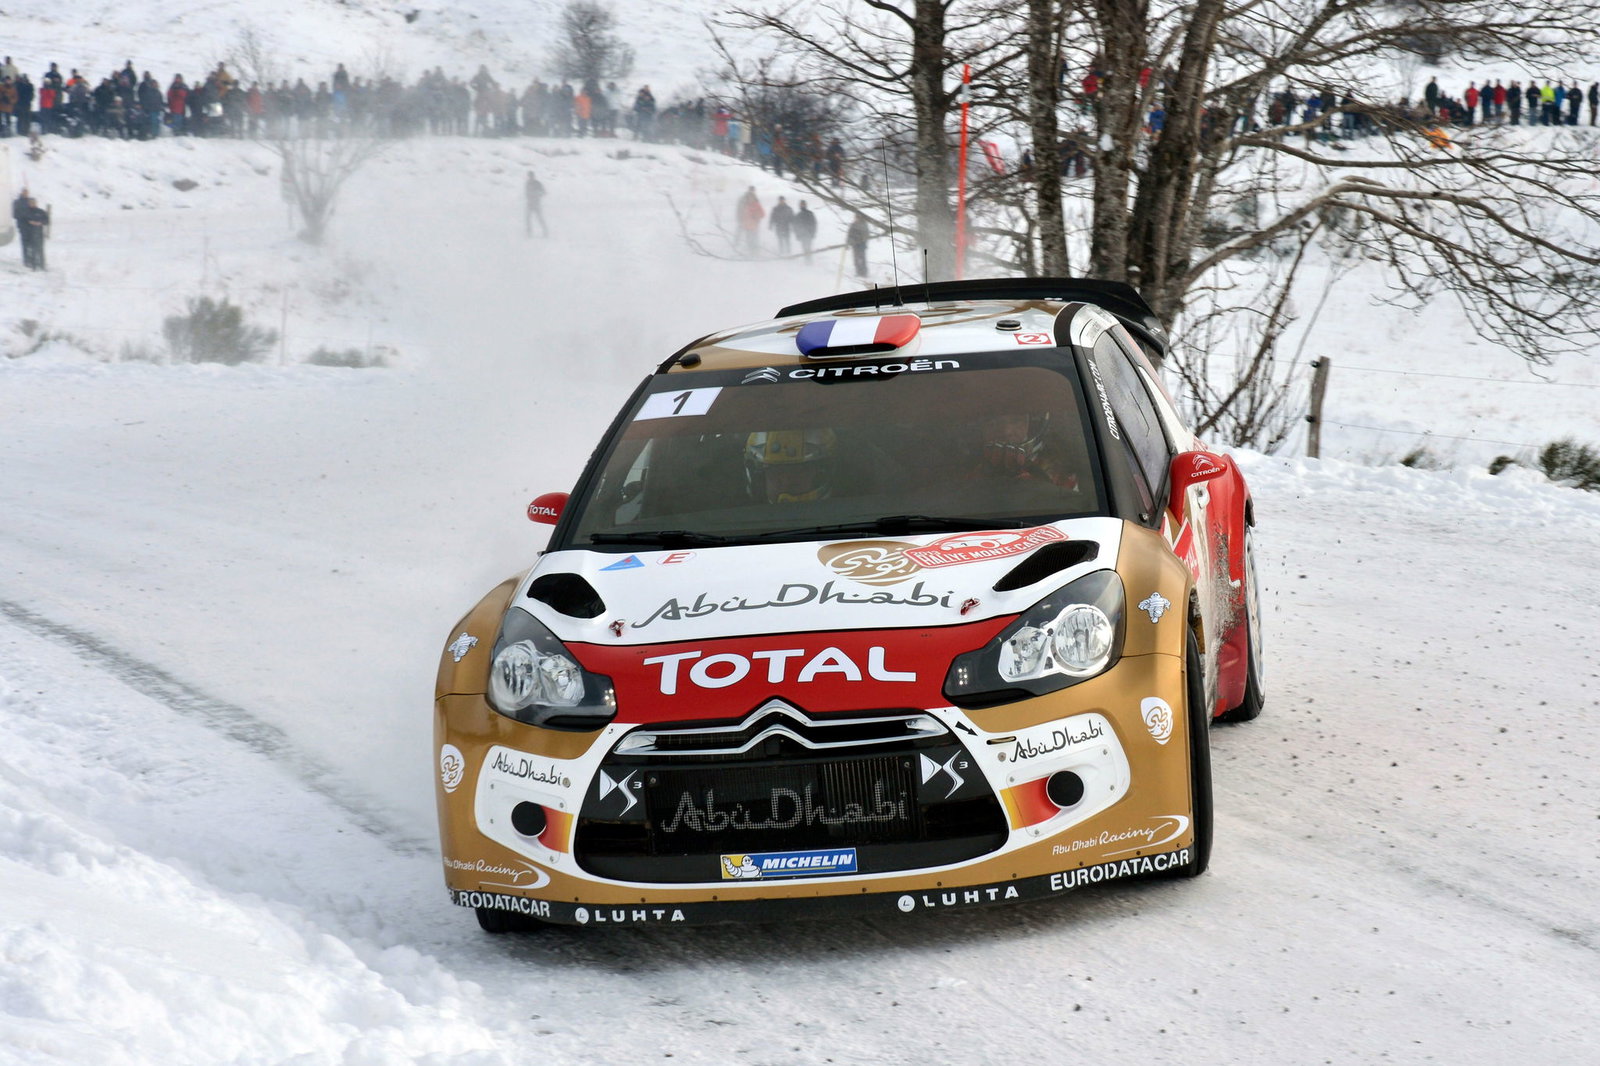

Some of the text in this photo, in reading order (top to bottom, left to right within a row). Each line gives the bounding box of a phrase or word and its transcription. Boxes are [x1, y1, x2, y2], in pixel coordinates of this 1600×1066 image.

[1023, 335, 1042, 343] 2
[672, 391, 693, 415] 1
[528, 504, 557, 517] TOTAL
[662, 552, 690, 565] E
[914, 531, 1060, 566] RALLYE MONTE-CARLO
[643, 646, 917, 695] TOTAL
[1052, 821, 1173, 856] Abu Dhabi Racing
[453, 859, 476, 871] Dhabi
[475, 859, 533, 883] Racing
[762, 854, 854, 870] MICHELIN
[1050, 849, 1189, 892] EURODATACAR
[922, 885, 1019, 908] LUHTA
[594, 909, 686, 923] LUHTA
